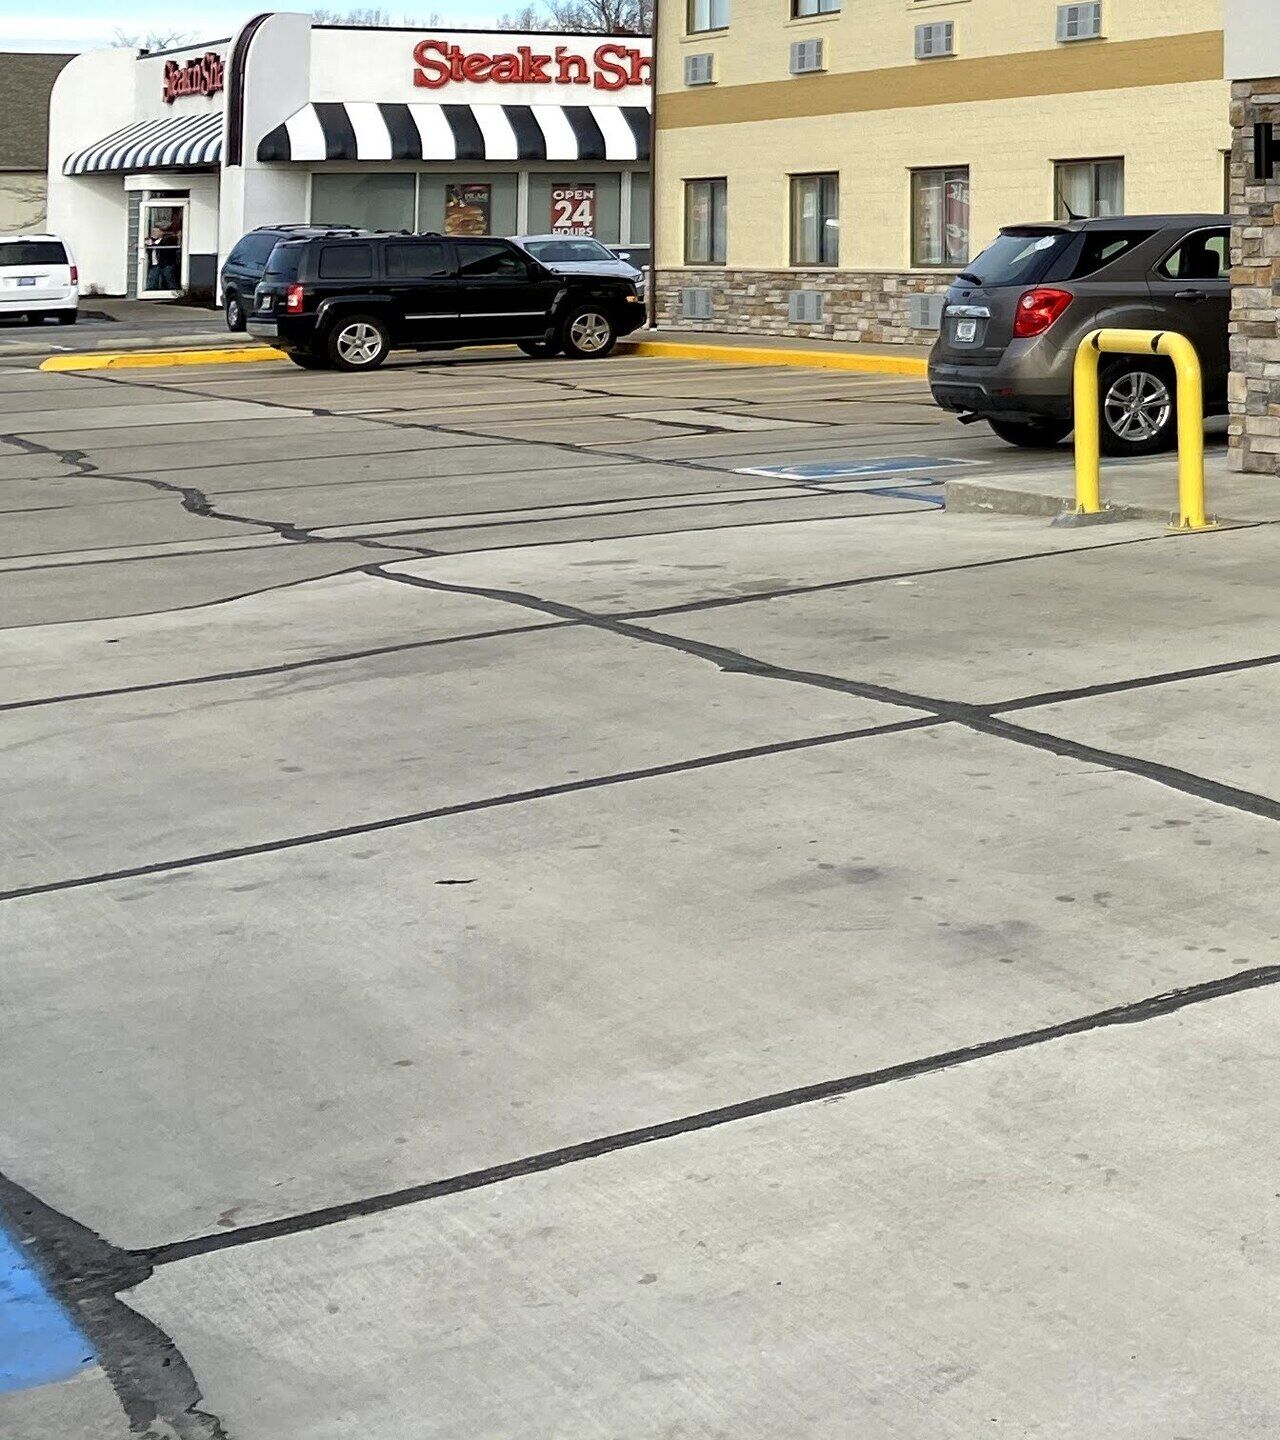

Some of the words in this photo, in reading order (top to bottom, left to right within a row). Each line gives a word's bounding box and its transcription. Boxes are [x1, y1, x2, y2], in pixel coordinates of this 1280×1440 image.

[413, 39, 552, 89] Steak
[552, 190, 594, 200] OPEN
[554, 200, 593, 227] 24
[552, 227, 594, 237] HOURS
